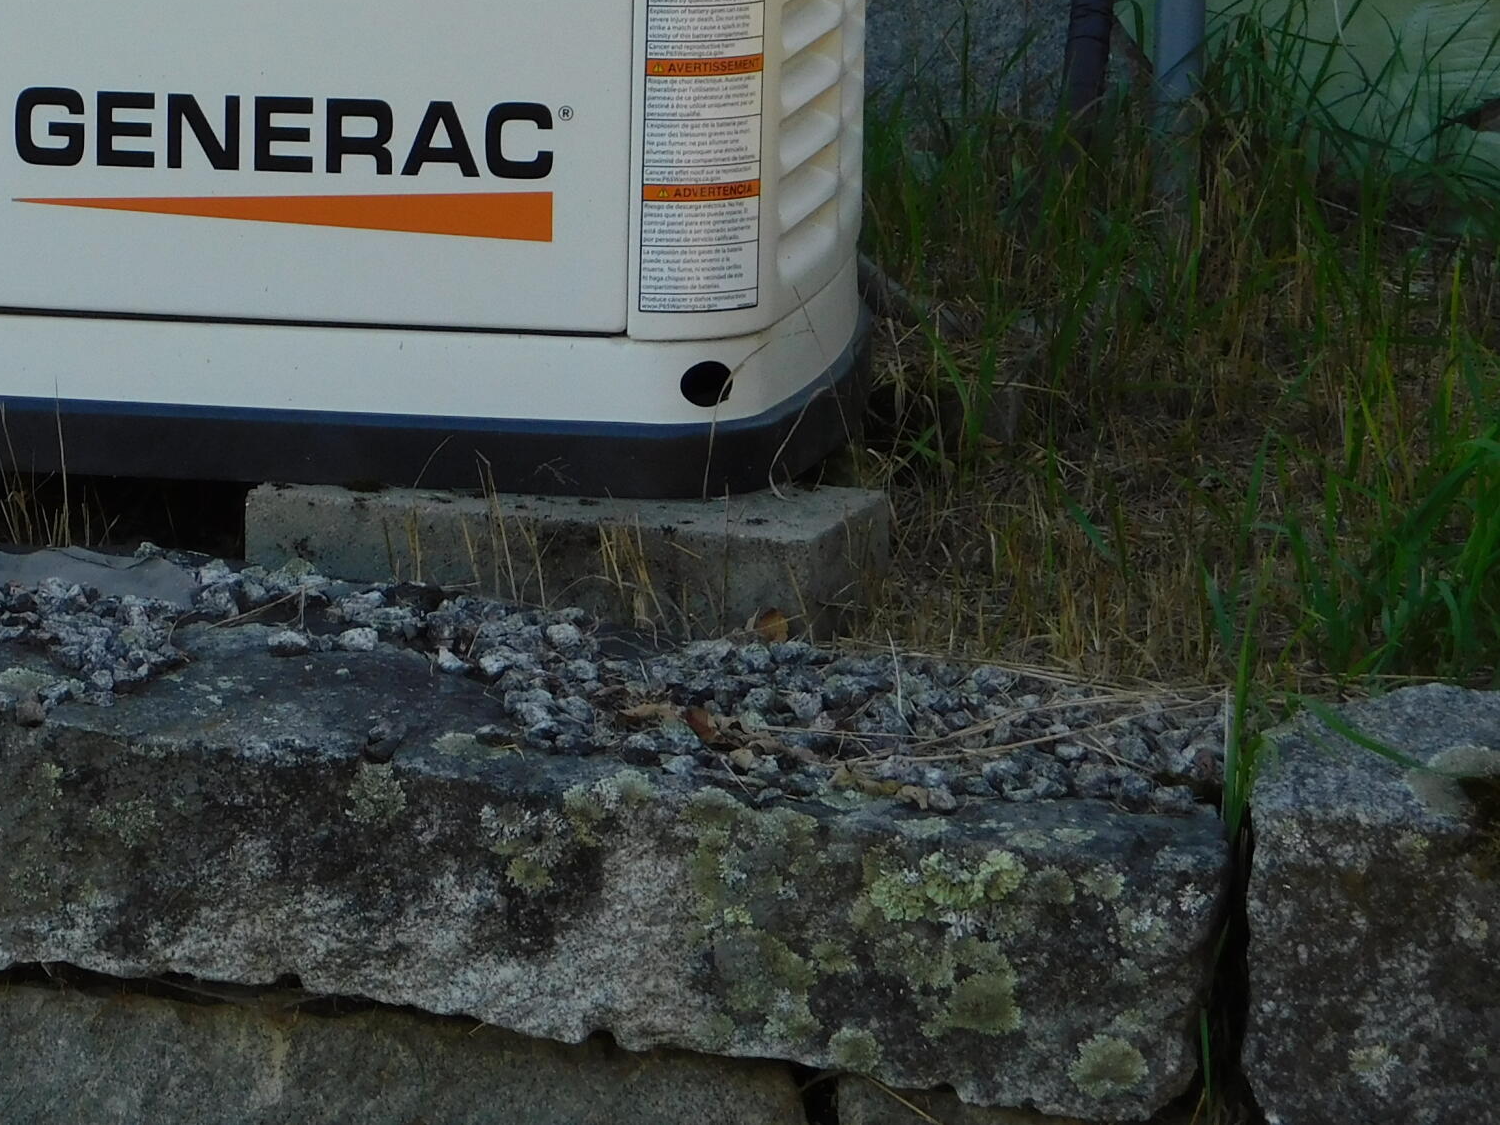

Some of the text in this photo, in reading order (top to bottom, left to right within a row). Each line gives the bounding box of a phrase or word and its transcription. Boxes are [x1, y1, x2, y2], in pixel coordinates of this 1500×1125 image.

[668, 58, 760, 73] AVERTISSEMENT
[14, 86, 554, 181] GENERAC
[674, 183, 753, 198] ADVERTENCIA
